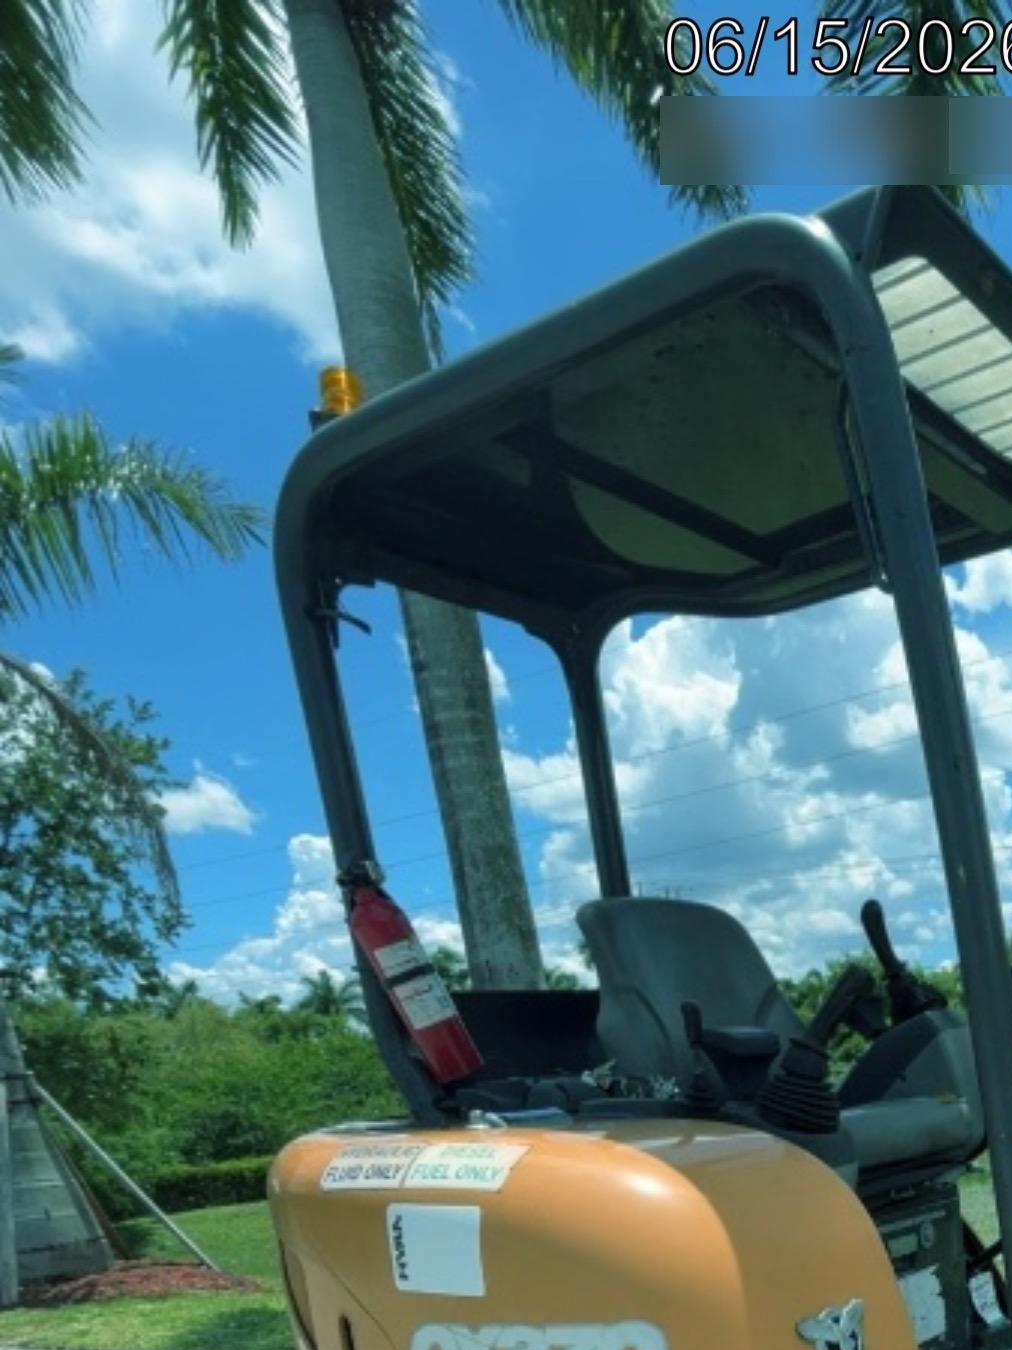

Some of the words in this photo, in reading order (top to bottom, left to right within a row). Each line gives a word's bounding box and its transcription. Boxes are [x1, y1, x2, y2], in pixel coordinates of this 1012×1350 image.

[363, 1163, 404, 1181] ONLY
[410, 1163, 451, 1181] FUEL
[454, 1164, 506, 1182] ONLY
